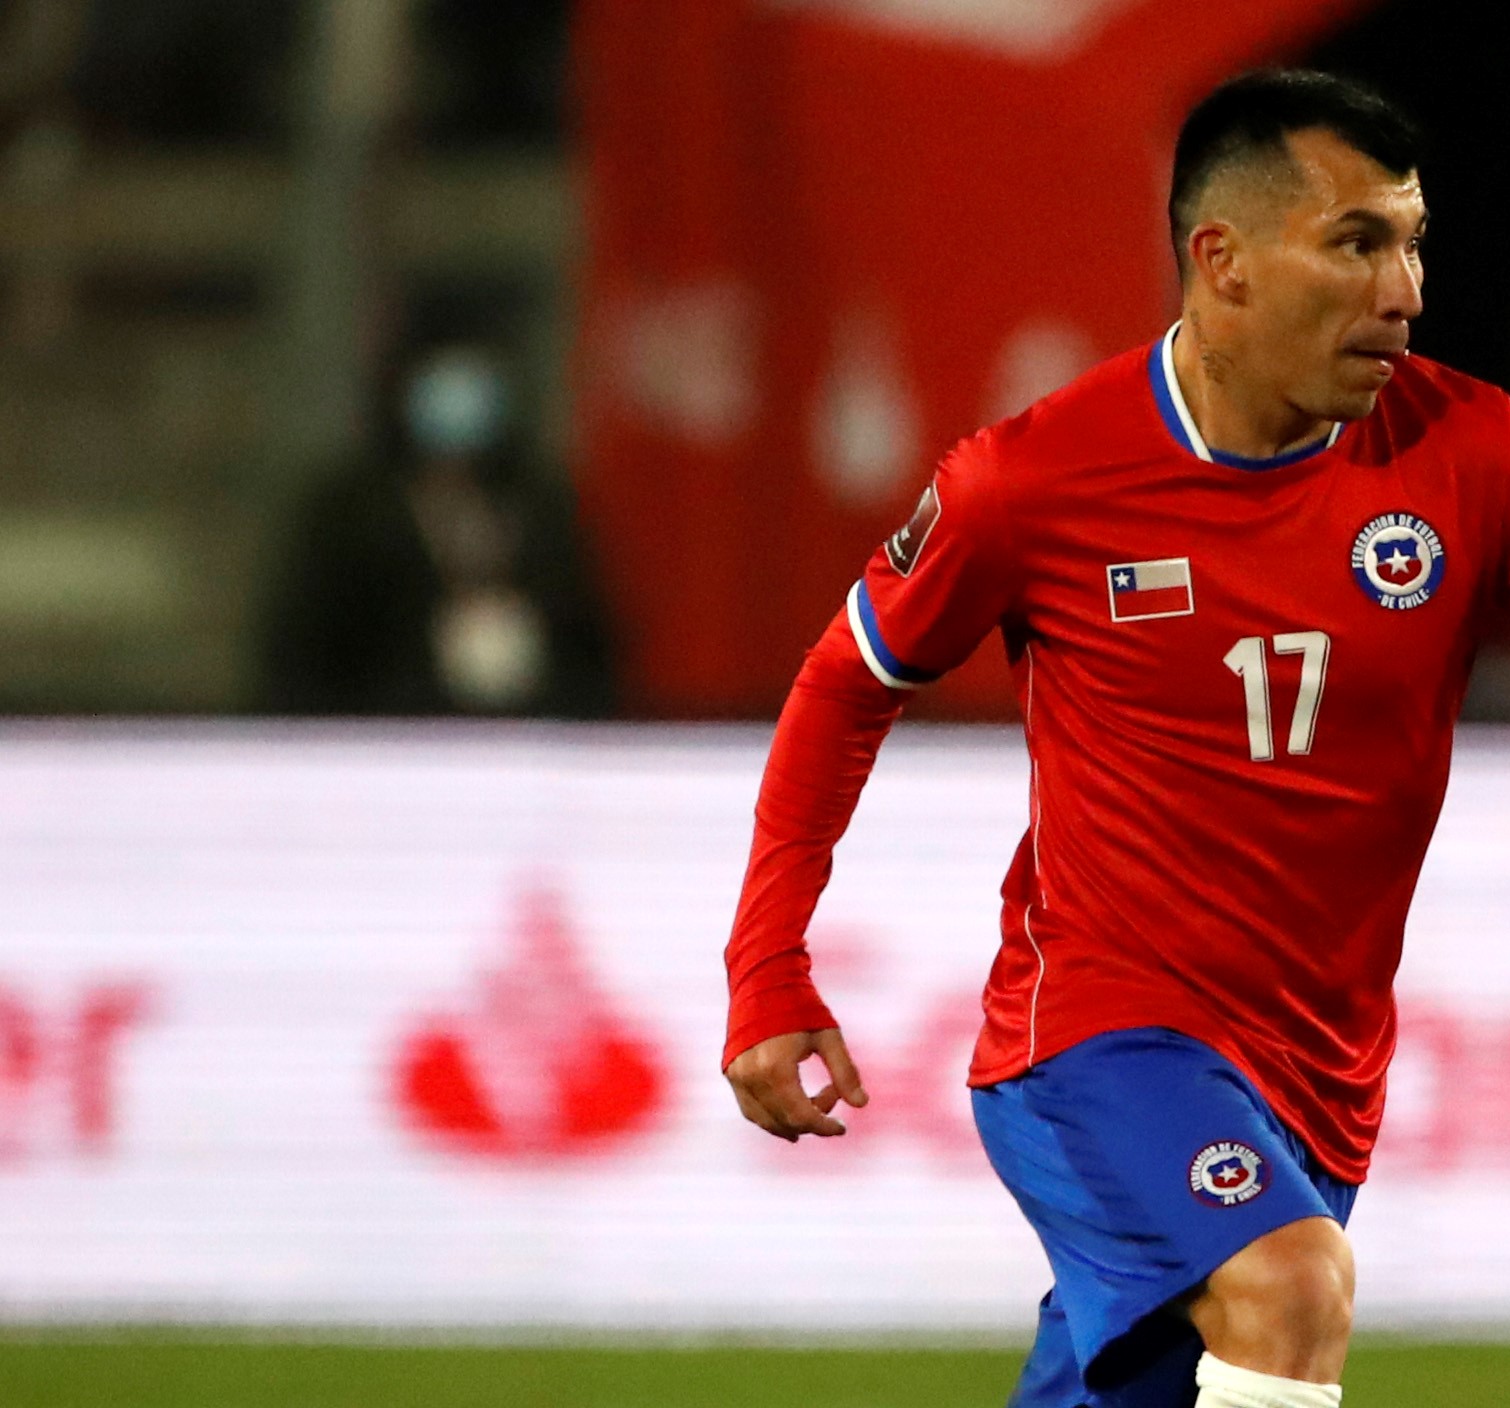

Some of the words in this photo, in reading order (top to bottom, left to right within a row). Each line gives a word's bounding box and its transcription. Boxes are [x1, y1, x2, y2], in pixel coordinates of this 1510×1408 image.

[1351, 513, 1396, 569] FEDERACION
[1398, 513, 1414, 528] DE
[1414, 520, 1444, 559] FUTBOL
[1380, 594, 1395, 609] DE
[1398, 587, 1429, 610] CHILE
[1222, 630, 1331, 761] 17
